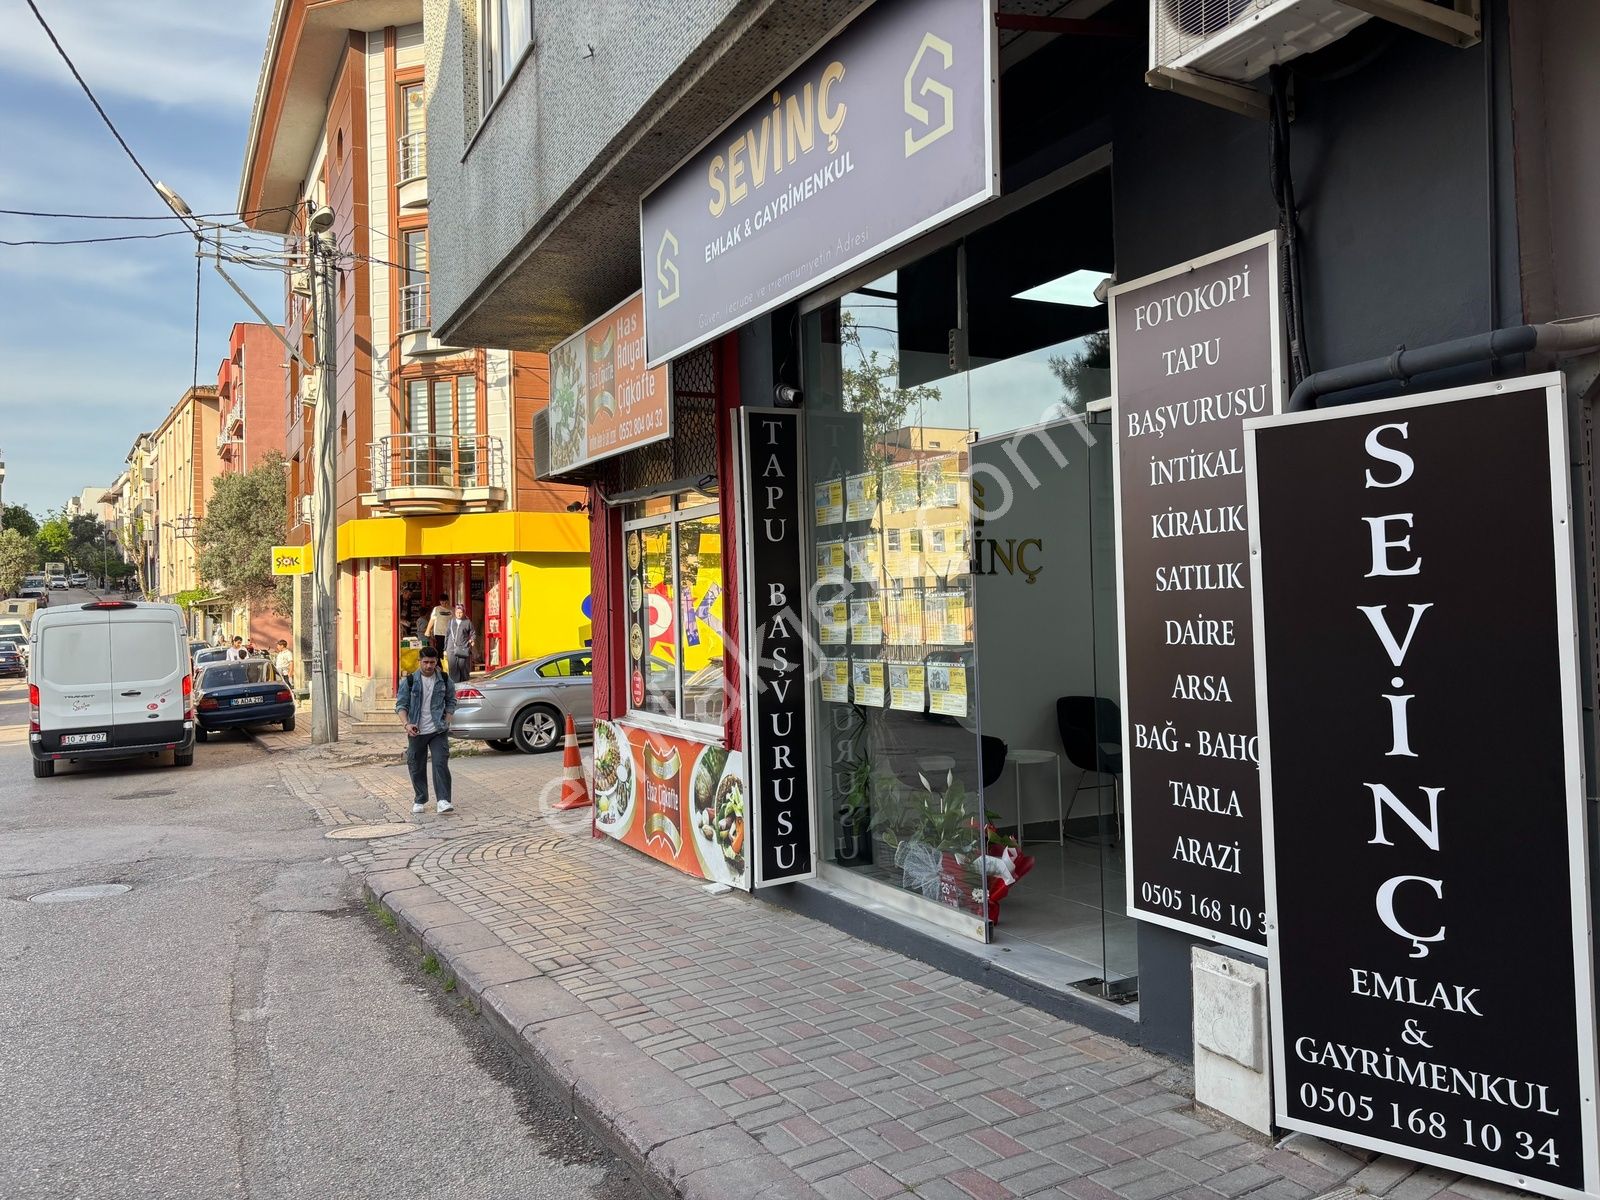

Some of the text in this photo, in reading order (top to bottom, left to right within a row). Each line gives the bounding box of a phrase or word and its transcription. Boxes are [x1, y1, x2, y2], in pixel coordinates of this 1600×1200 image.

[707, 61, 847, 219] SEVİNÇ
[704, 151, 855, 264] EMLAK & GAYRİMENKUL
[1135, 264, 1251, 332] FOTOKOPİ
[617, 313, 636, 340] Has
[1162, 338, 1221, 376] TAPU
[618, 374, 656, 416] Çiğköfte
[1128, 384, 1266, 438] BAŞVURUSU
[762, 420, 787, 542] TAPU
[1150, 448, 1243, 486] İNTİKAL
[1151, 504, 1246, 539] KİRALIK
[276, 557, 300, 568] ŞOK
[1156, 563, 1245, 592] SATILIK
[1165, 613, 1236, 646] DAİRE
[1172, 674, 1232, 702] ARSA
[1356, 421, 1446, 958] SEVİNÇ
[67, 733, 105, 744] 10 ZT 097
[767, 583, 797, 869] BAŞVURUSU
[1134, 720, 1178, 753] BAĞ
[1197, 730, 1260, 770] BAHÇ
[1169, 780, 1243, 818] TARLA
[1172, 835, 1242, 875] ARAZİ
[1141, 881, 1267, 935] 0505 168 10 3
[1349, 967, 1483, 1017] EMLAK
[1401, 1018, 1434, 1049] &
[1295, 1036, 1560, 1116] GAYRİMENKUL
[1299, 1082, 1560, 1168] 0505 168 10 34
